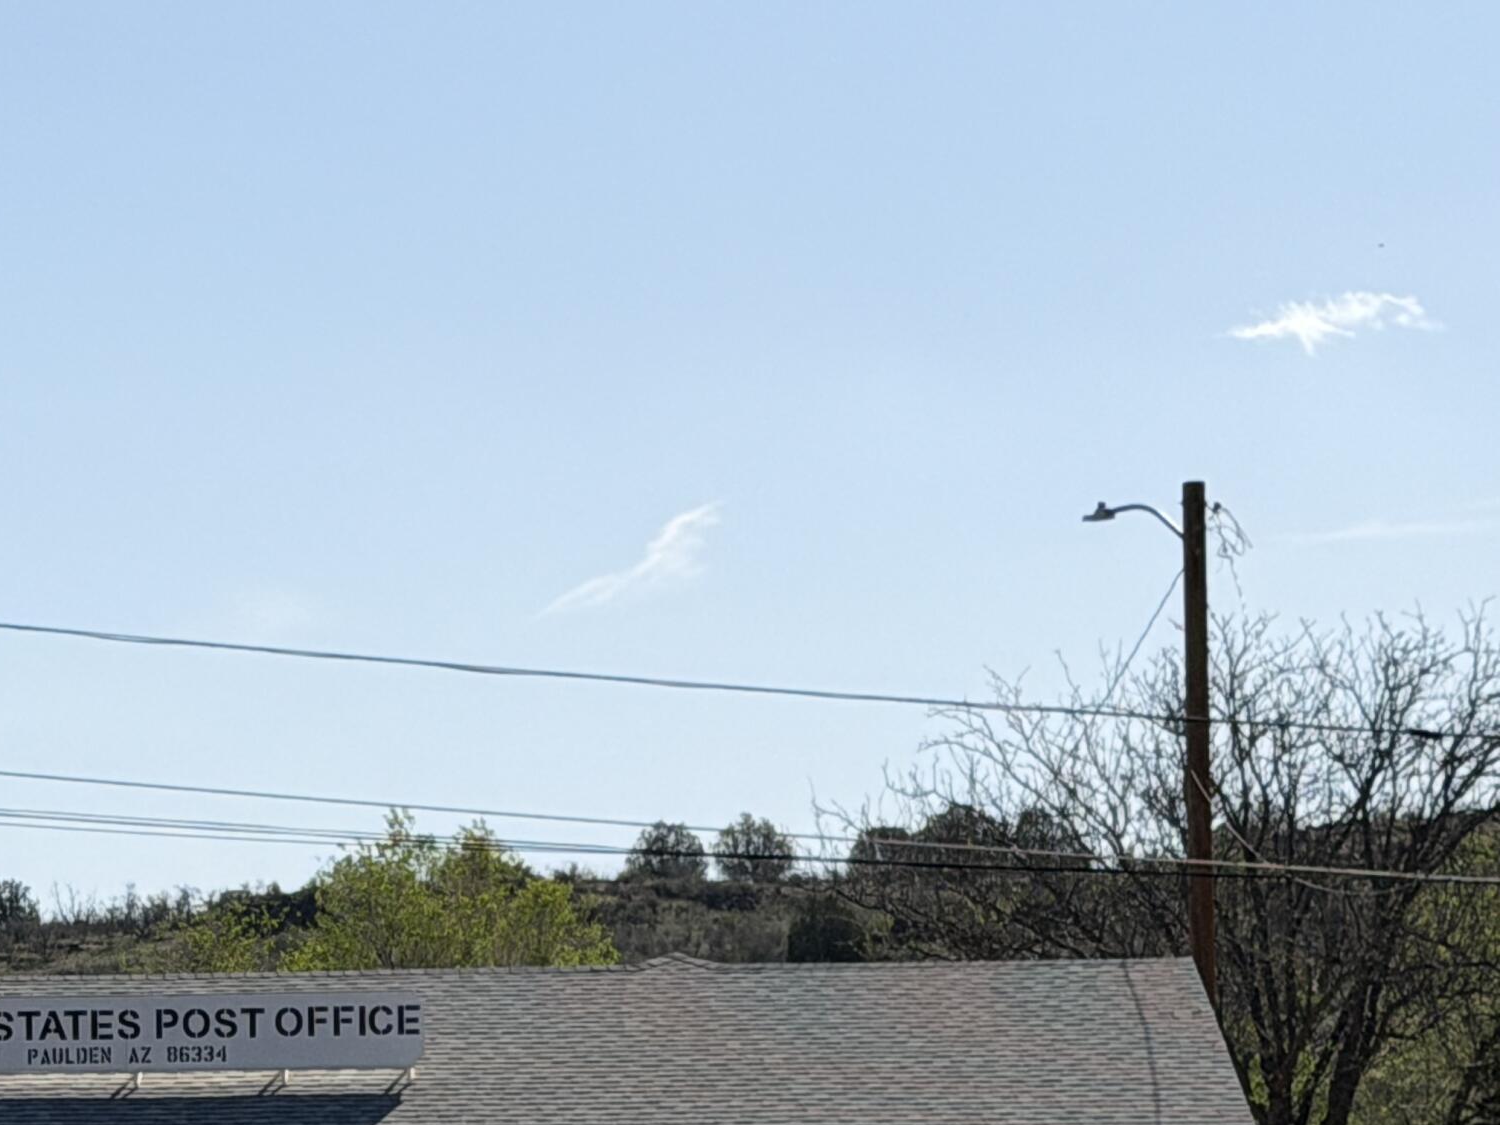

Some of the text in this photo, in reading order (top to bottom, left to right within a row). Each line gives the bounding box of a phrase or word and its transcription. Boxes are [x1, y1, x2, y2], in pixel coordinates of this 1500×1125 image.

[155, 1007, 265, 1040] POST
[275, 1005, 421, 1037] OFFICE
[27, 1045, 228, 1065] PAULDEN AZ 86334
